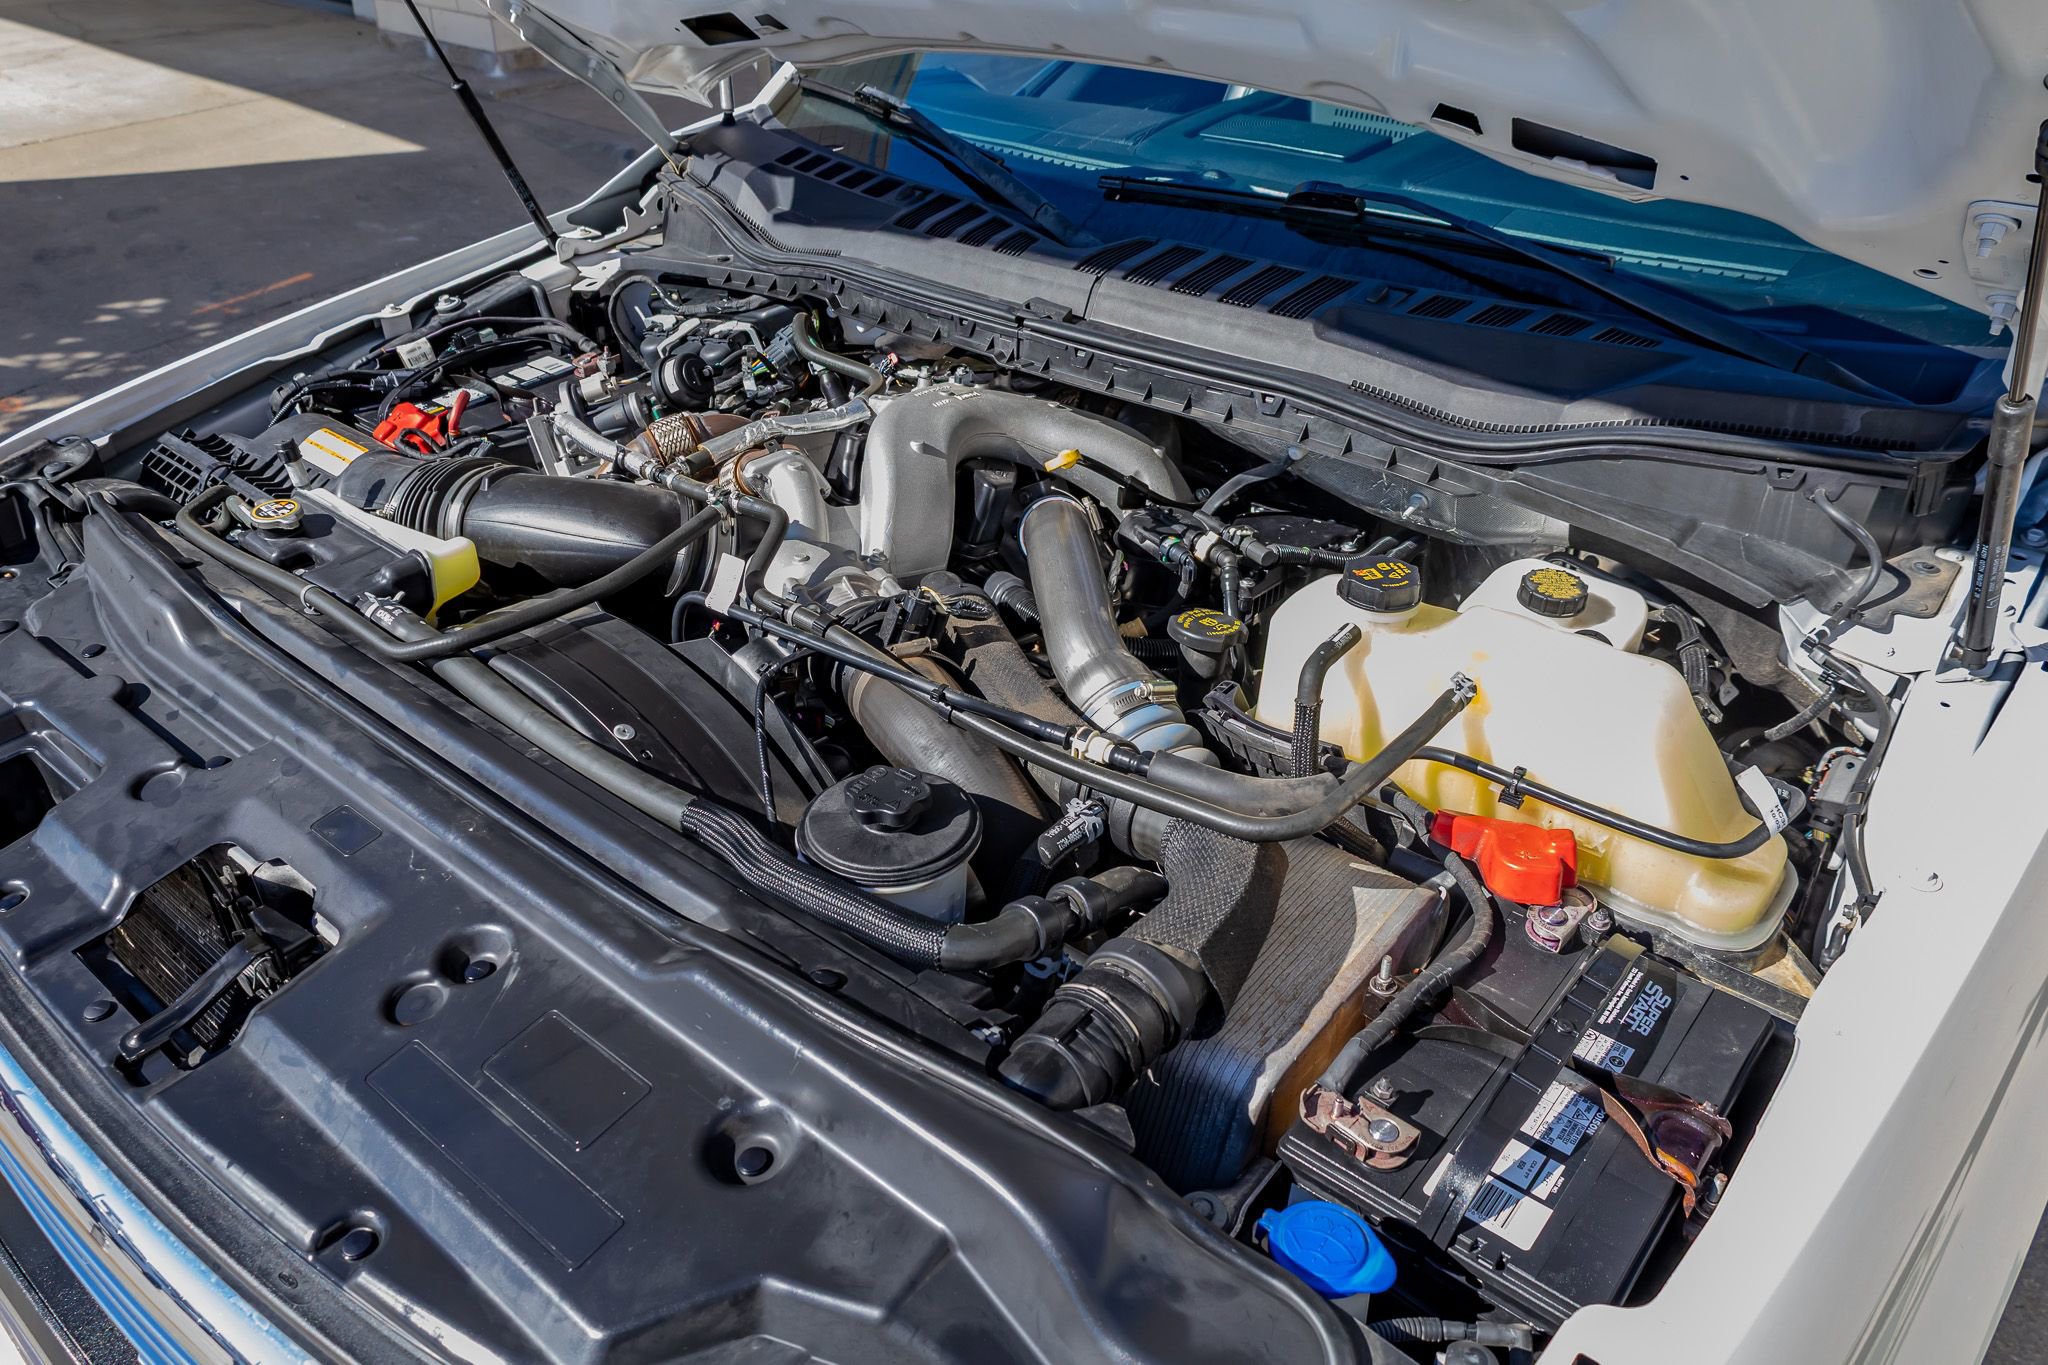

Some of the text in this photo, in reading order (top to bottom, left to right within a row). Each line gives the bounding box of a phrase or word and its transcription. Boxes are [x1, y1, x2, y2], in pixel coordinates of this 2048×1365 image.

[1625, 980, 1663, 1031] START
[1636, 992, 1672, 1036] SUPER
[1529, 1159, 1538, 1169] CCA
[1555, 1175, 1565, 1187] PART
